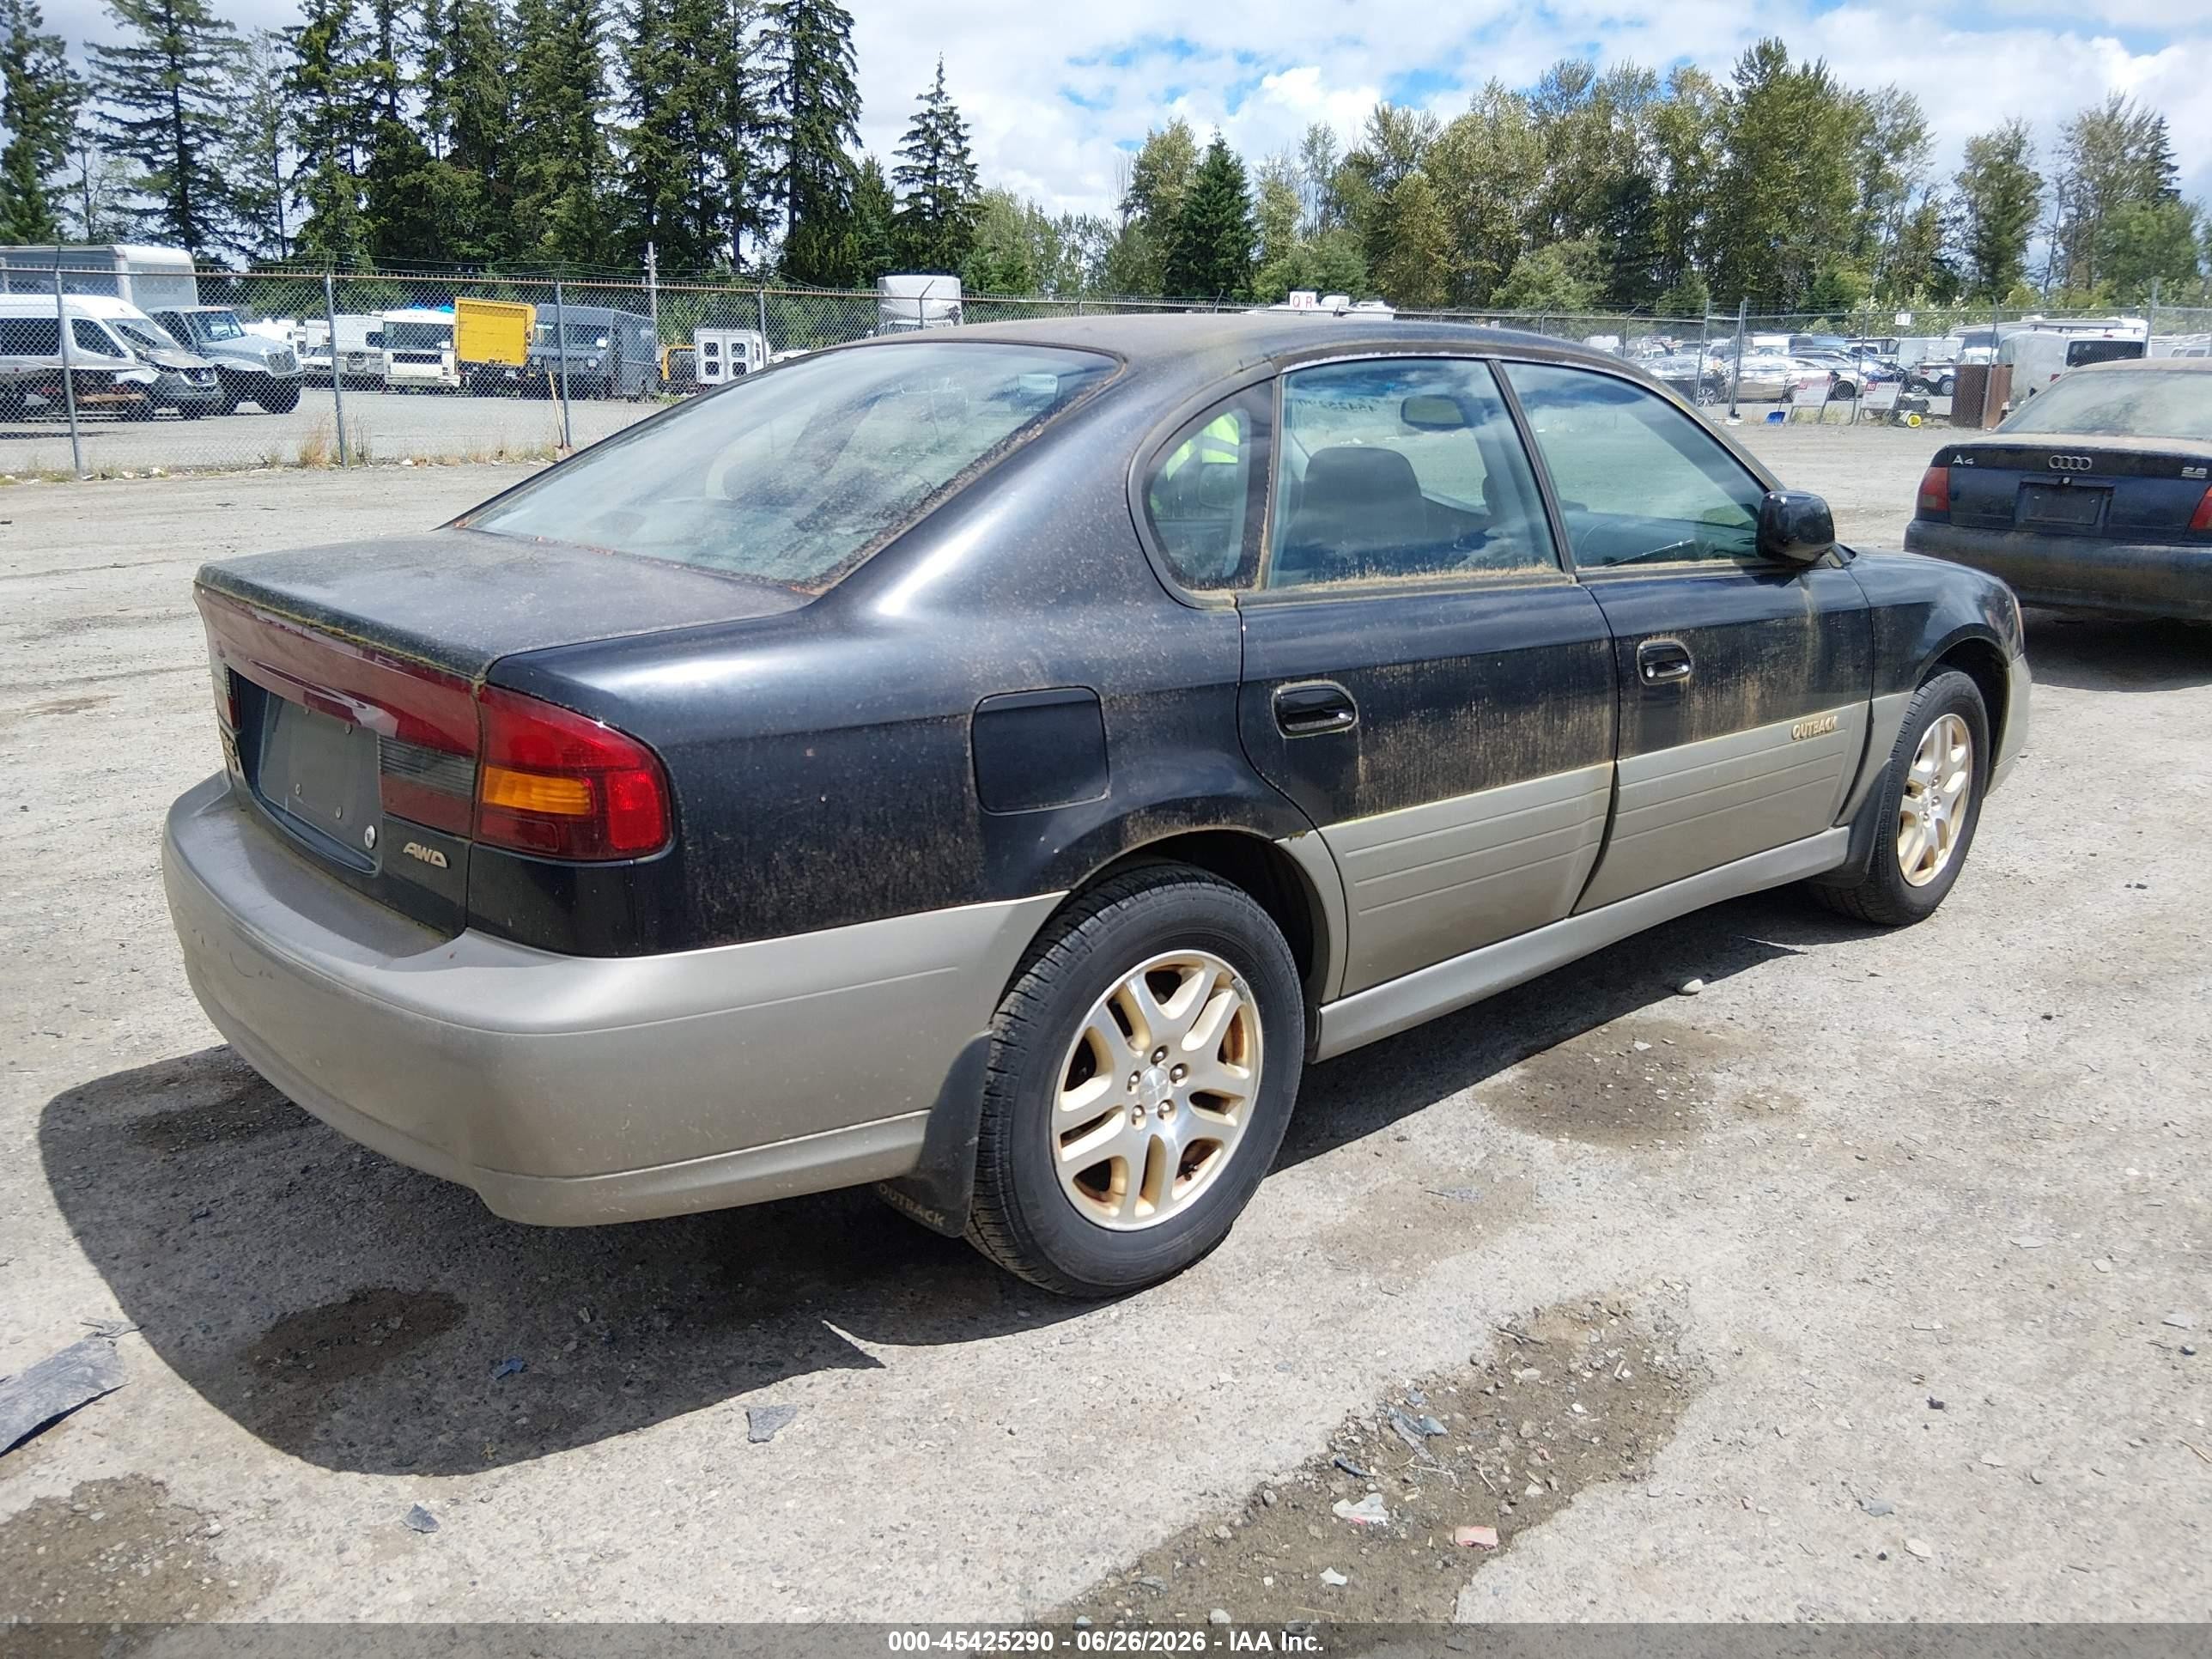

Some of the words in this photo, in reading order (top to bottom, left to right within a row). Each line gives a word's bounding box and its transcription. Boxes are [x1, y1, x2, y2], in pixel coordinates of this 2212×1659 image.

[1952, 454, 1973, 465] A4
[1792, 715, 1838, 739] OUTBACK
[403, 842, 447, 868] AWD
